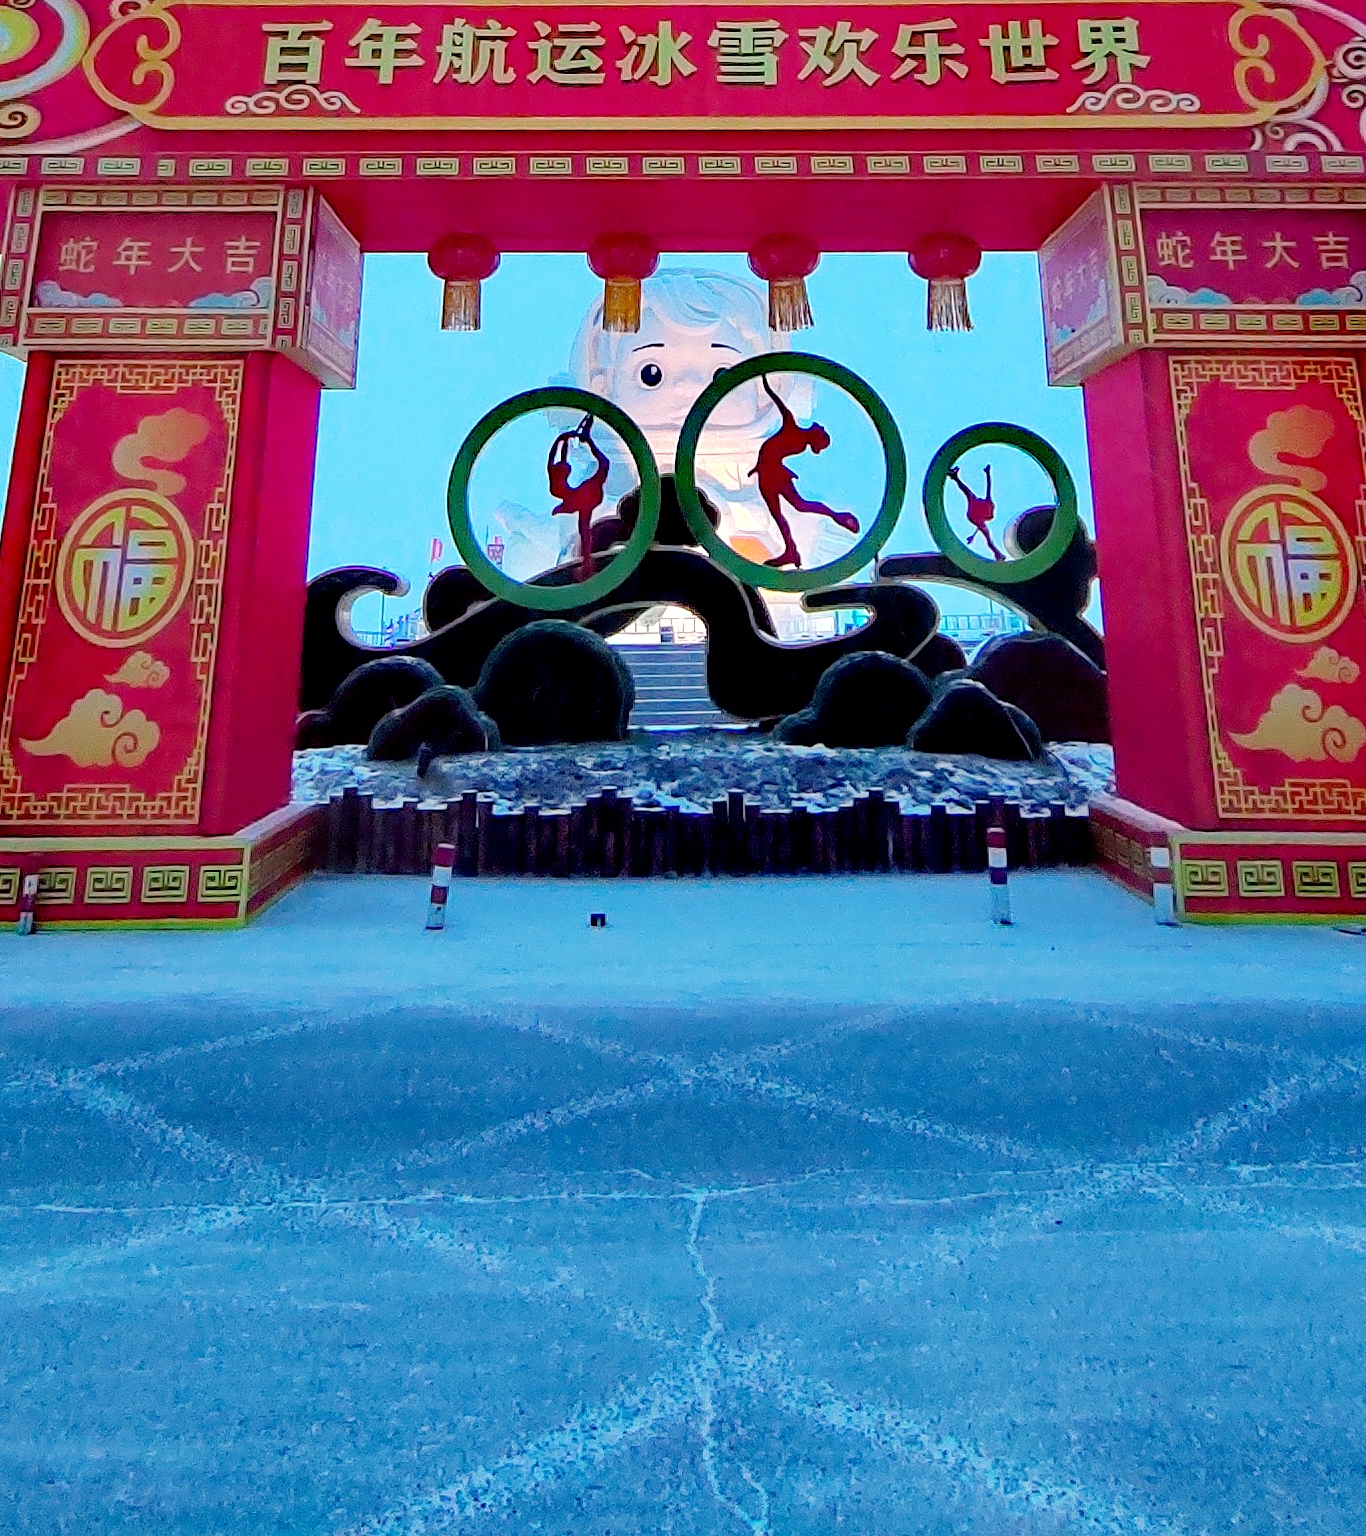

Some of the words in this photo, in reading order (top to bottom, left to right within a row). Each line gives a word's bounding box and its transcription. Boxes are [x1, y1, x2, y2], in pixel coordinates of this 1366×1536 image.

[260, 17, 1152, 87] 百年航运冰雪欢乐世界
[58, 235, 262, 276] 蛇年大吉
[1156, 230, 1351, 272] 蛇年大吉
